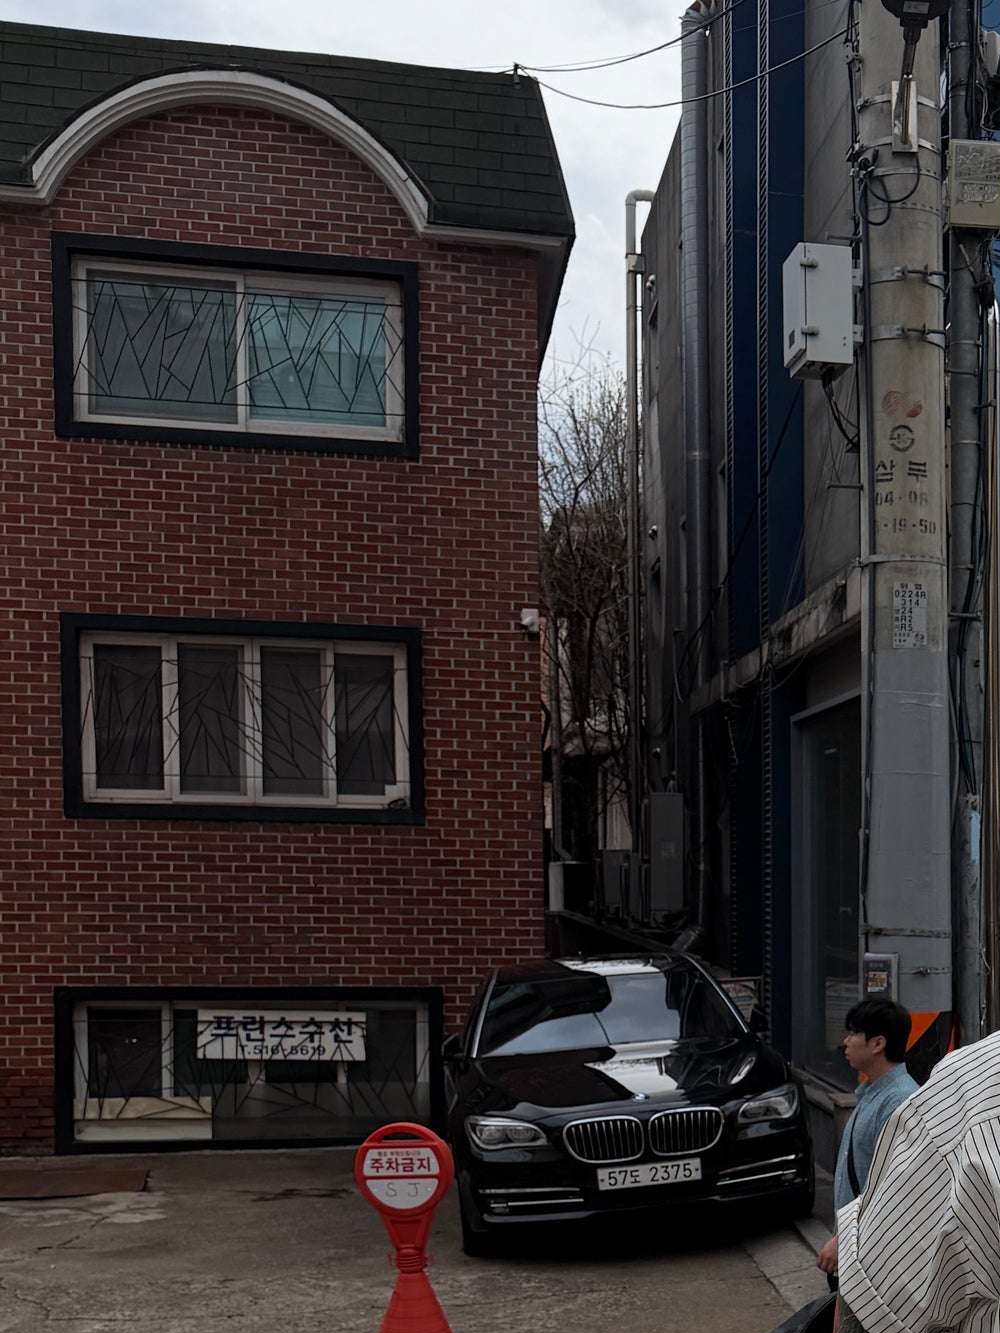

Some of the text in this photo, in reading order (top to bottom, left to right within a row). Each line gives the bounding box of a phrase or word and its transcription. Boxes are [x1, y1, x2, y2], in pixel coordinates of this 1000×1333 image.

[211, 1016, 353, 1043] 프린스수선
[370, 1156, 431, 1173] 주차금지
[608, 1163, 692, 1187] 57도 2375
